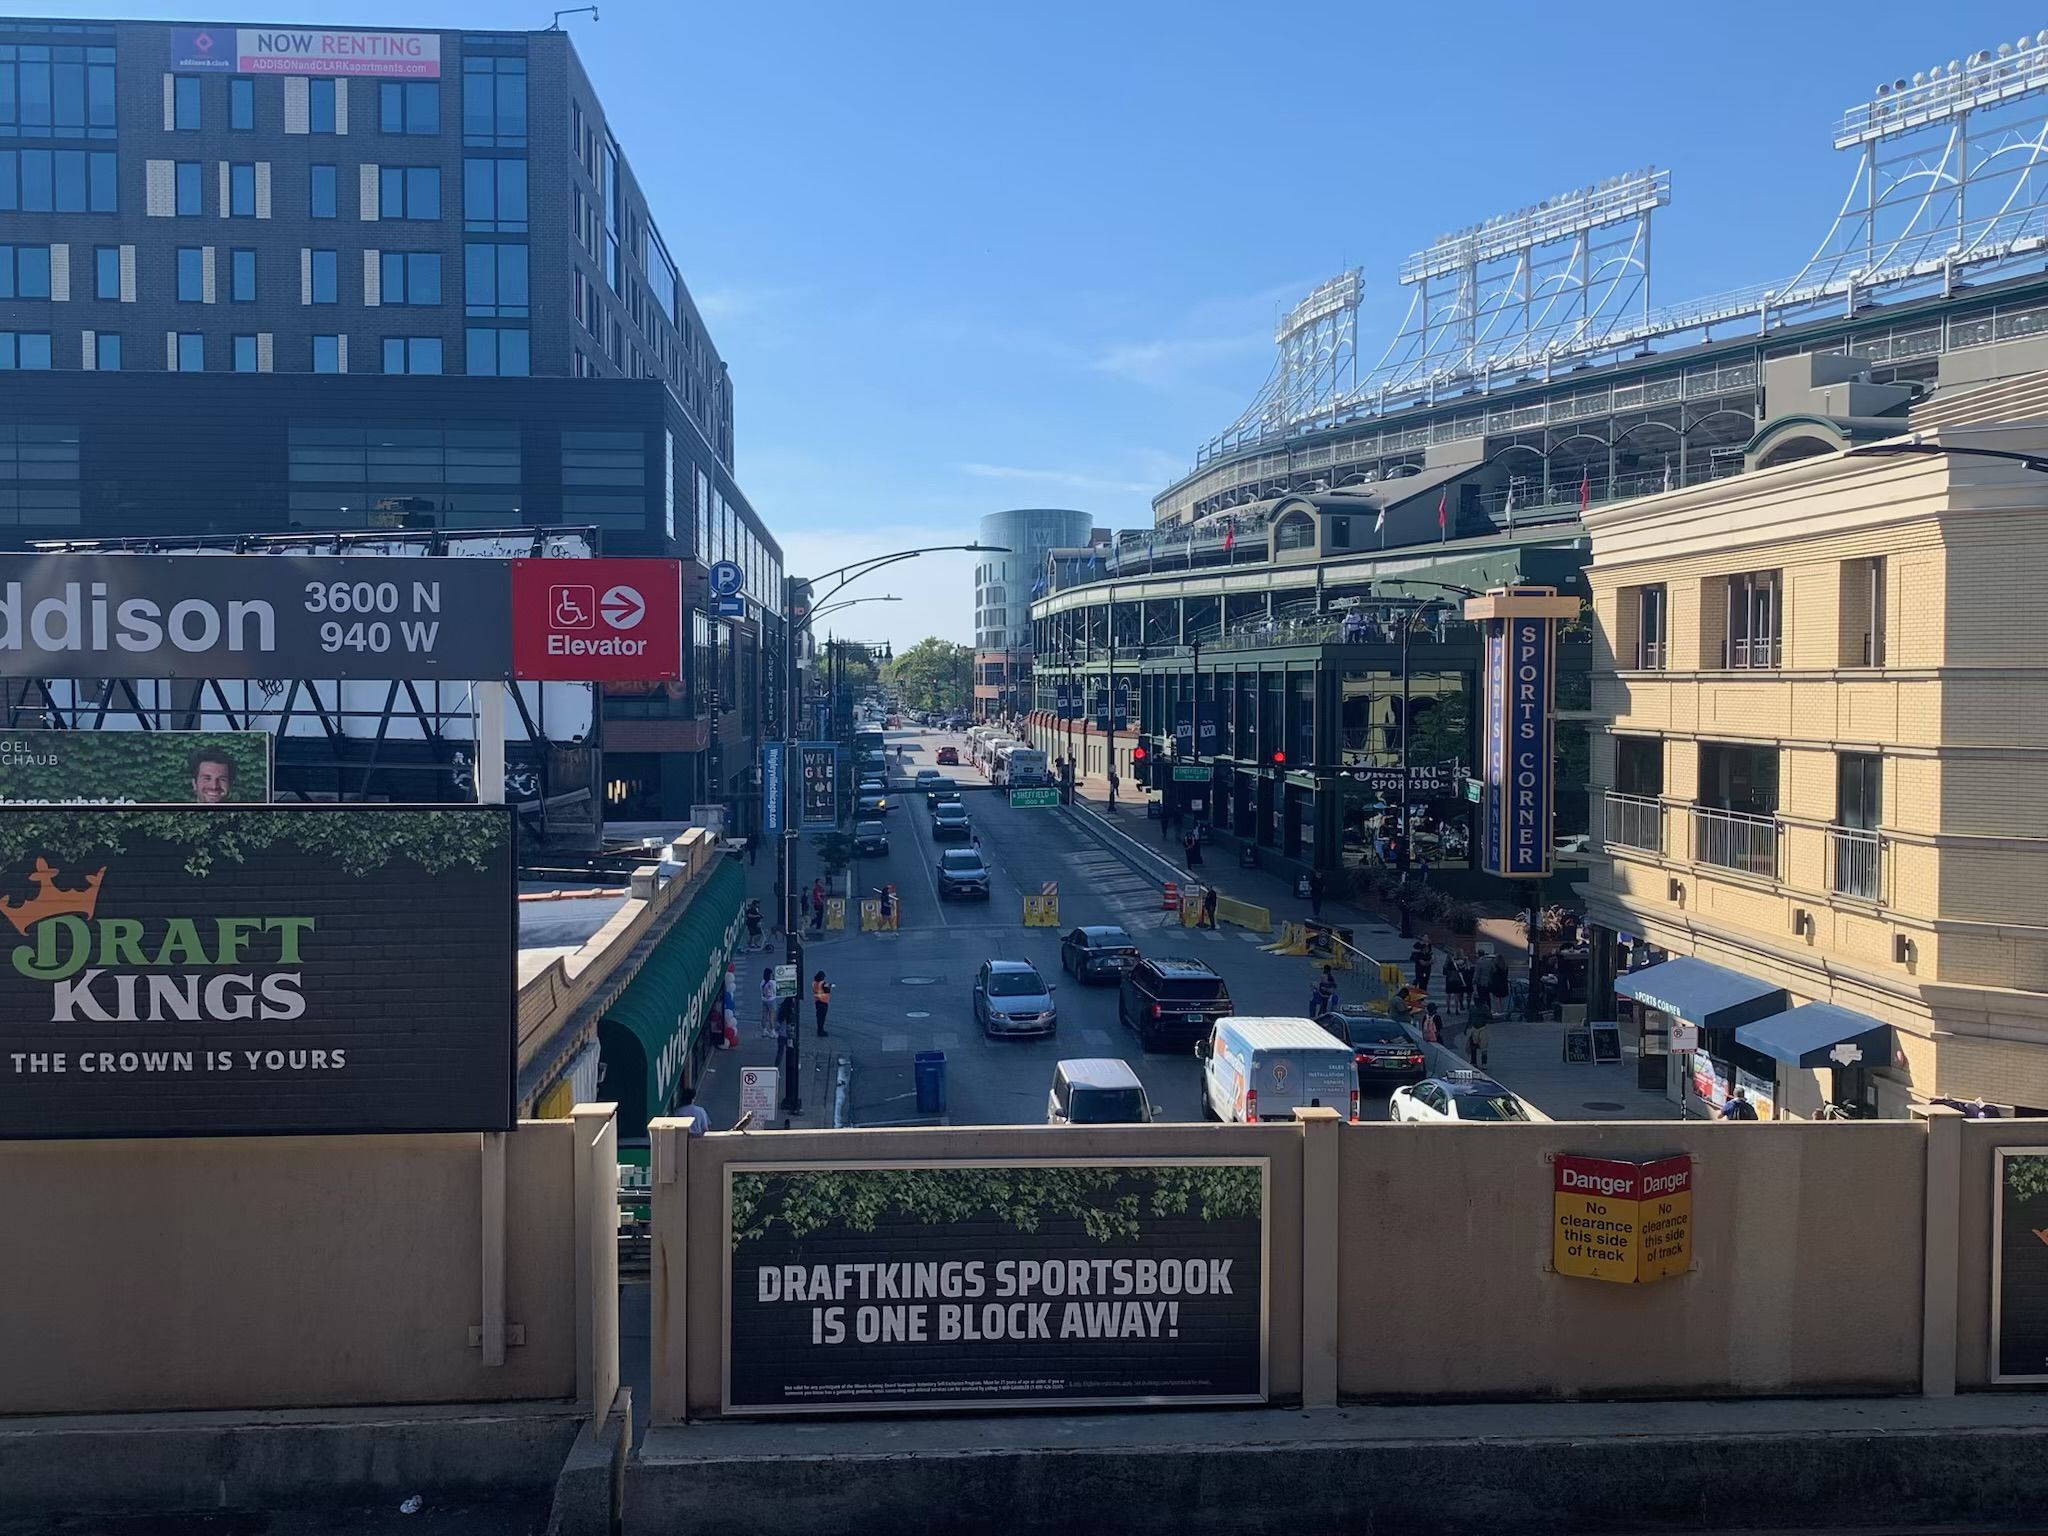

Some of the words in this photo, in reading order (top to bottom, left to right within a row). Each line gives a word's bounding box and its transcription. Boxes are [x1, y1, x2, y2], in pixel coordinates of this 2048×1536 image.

[257, 33, 312, 52] NOW
[321, 36, 422, 56] RENTING
[252, 58, 427, 74] ADDISONandCLARKapartments.com
[304, 581, 399, 614] 3600
[413, 582, 440, 613] N
[320, 621, 391, 653] 940
[400, 622, 439, 653] W
[547, 634, 647, 656] Elevator
[1519, 626, 1536, 739] SPORTS
[1017, 791, 1050, 799] SHEFFIELD
[1371, 780, 1459, 790] SPORTSBO
[1492, 751, 1500, 862] CORNER
[1518, 752, 1536, 864] CORNER
[12, 914, 315, 981] DRAFT
[50, 968, 307, 1022] KINGS
[1657, 998, 1681, 1018] CORNER
[10, 1053, 66, 1073] THE
[79, 1051, 193, 1072] CROWN
[206, 1051, 233, 1071] IS
[245, 1049, 346, 1070] YOURS
[1562, 1169, 1634, 1195] Danger
[1643, 1171, 1689, 1194] Danger
[1586, 1202, 1607, 1215] No
[1658, 1203, 1672, 1215] No
[1560, 1214, 1633, 1233] clearance
[1642, 1214, 1688, 1234] clearance
[1564, 1229, 1592, 1243] this
[1596, 1233, 1628, 1248] side
[1645, 1235, 1663, 1248] this
[1665, 1228, 1685, 1242] side
[1567, 1245, 1582, 1256] of
[1587, 1247, 1624, 1262] track
[1647, 1249, 1658, 1262] of
[1659, 1244, 1683, 1259] track
[758, 1261, 986, 1303] DRAFTKINGS
[995, 1258, 1234, 1297] SPORTSBOOK
[811, 1307, 846, 1345] IS
[856, 1305, 927, 1342] ONE
[939, 1302, 1053, 1341] BLOCK
[1059, 1301, 1179, 1339] AWAY!
